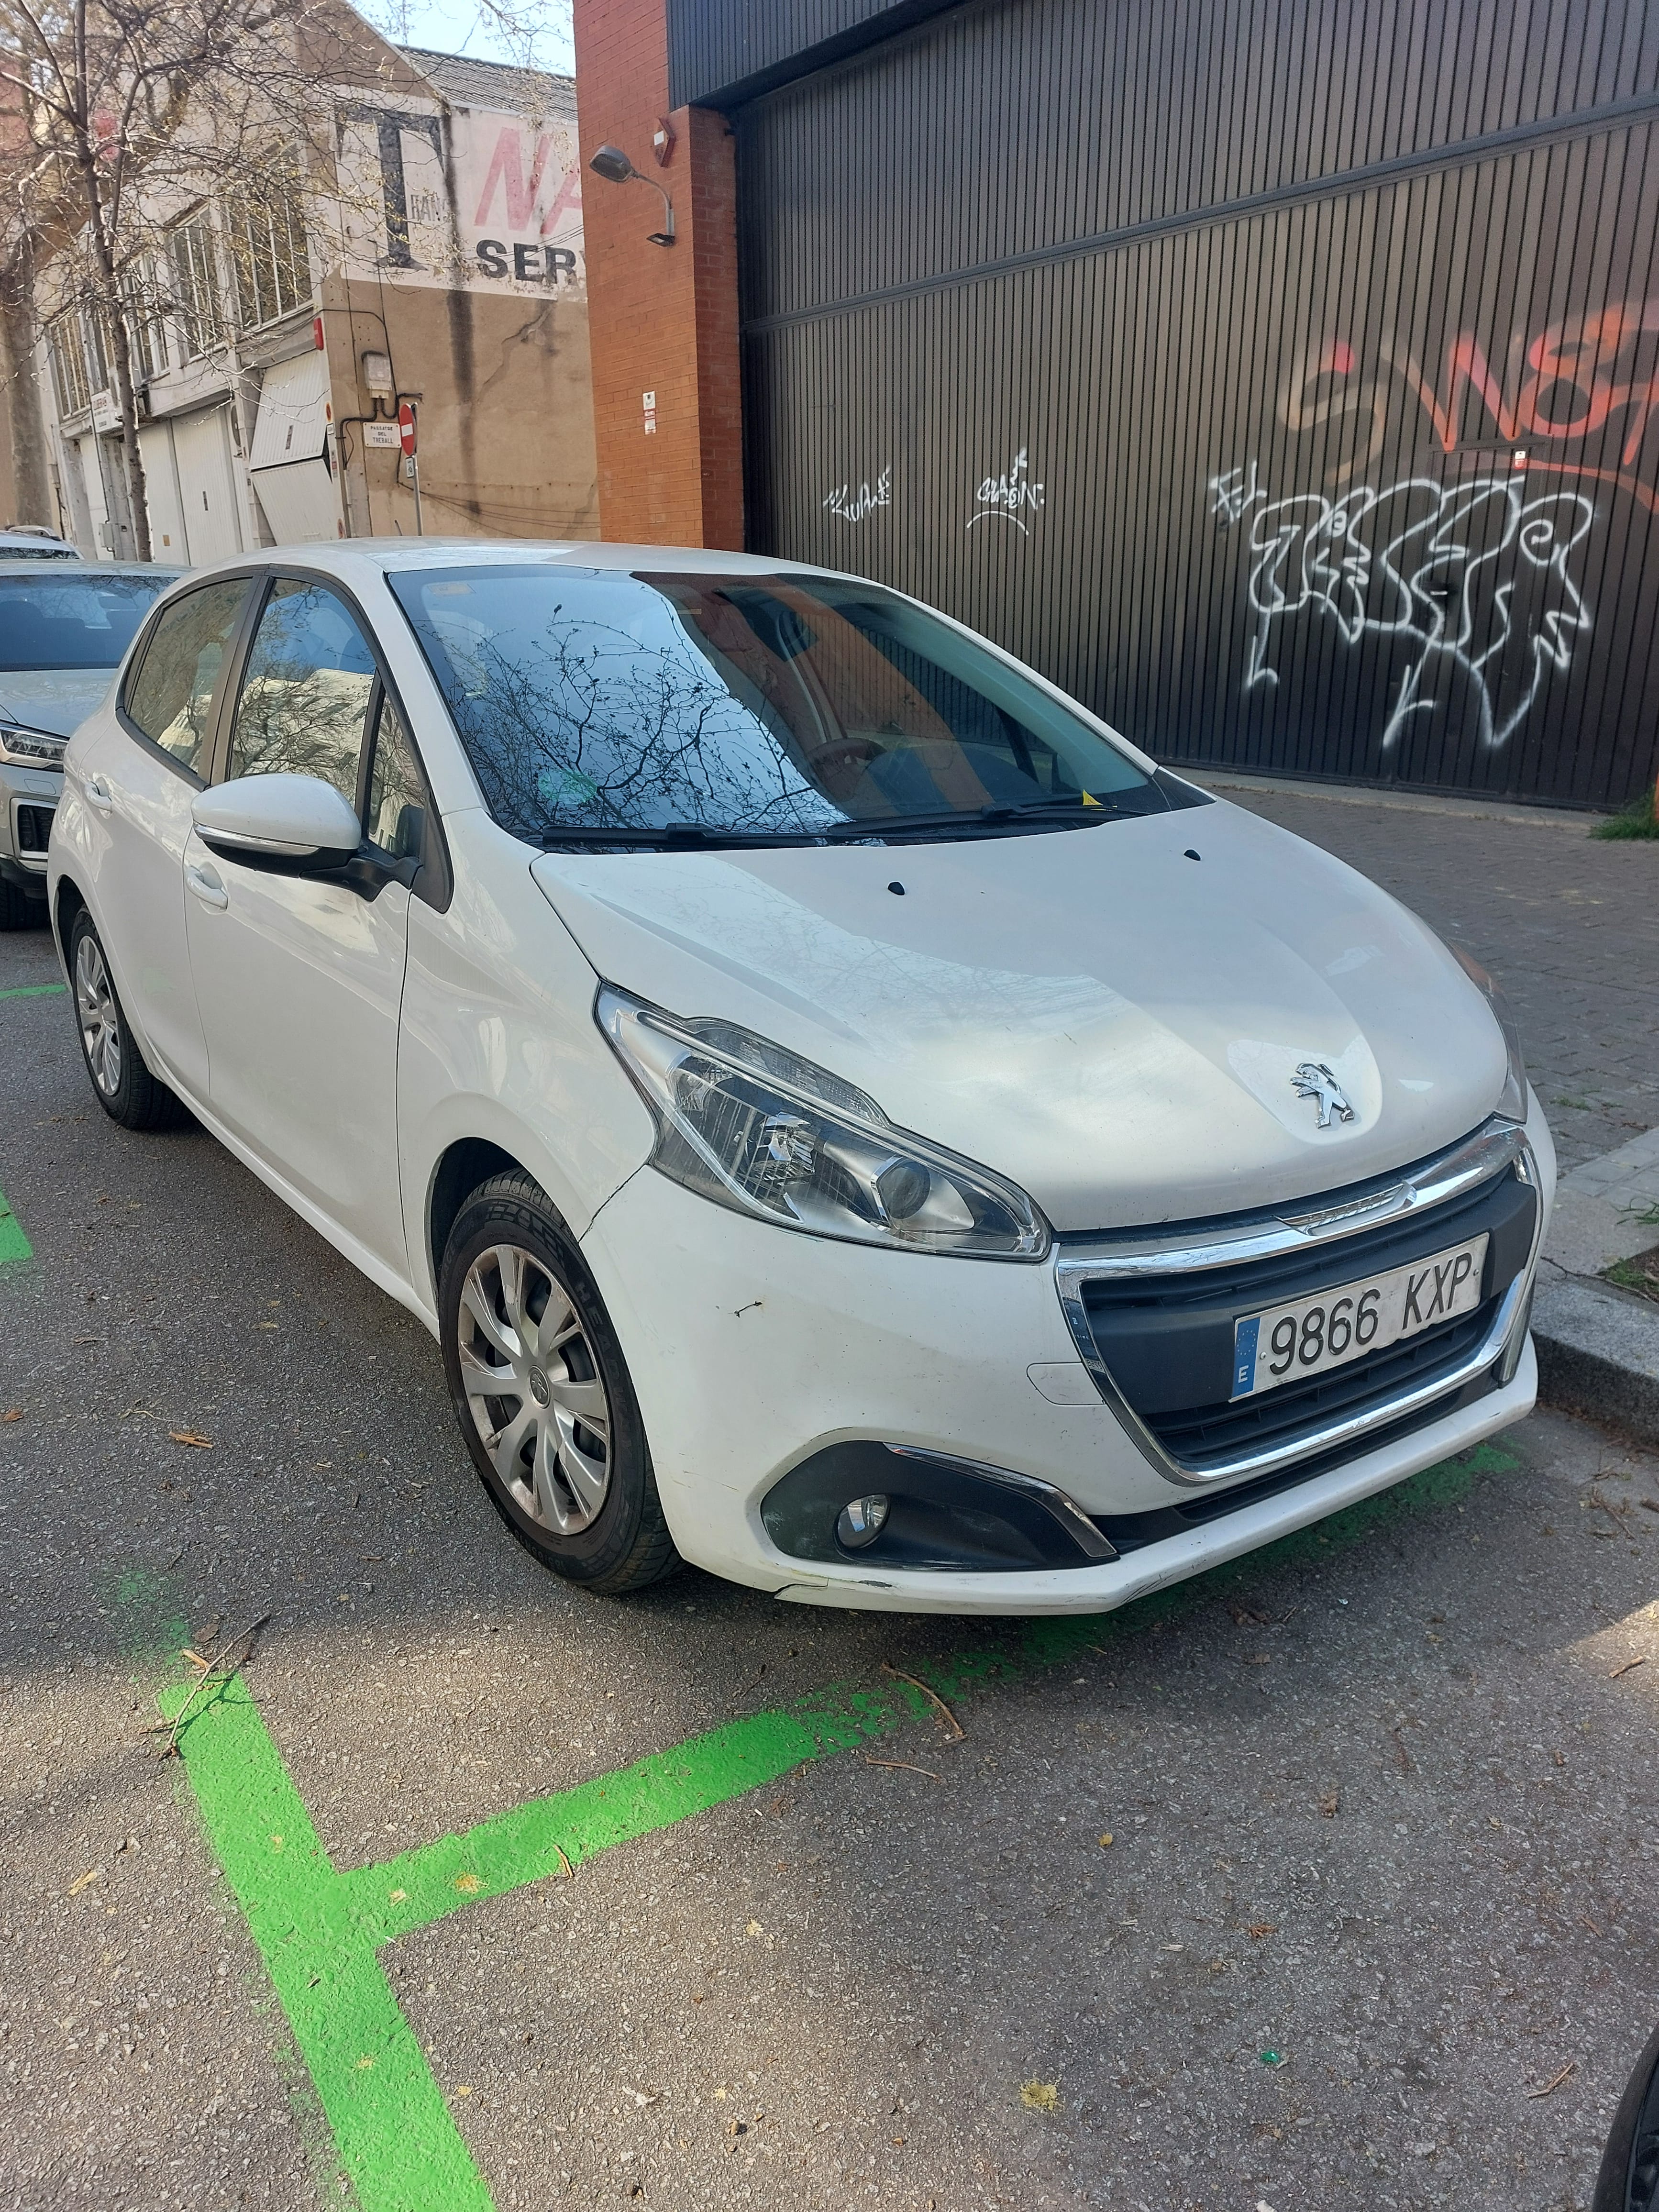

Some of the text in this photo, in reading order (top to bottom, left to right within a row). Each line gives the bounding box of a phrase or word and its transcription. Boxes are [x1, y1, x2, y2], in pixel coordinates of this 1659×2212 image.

[1269, 1252, 1473, 1375] 9866 KXP
[1238, 1365, 1249, 1383] E
